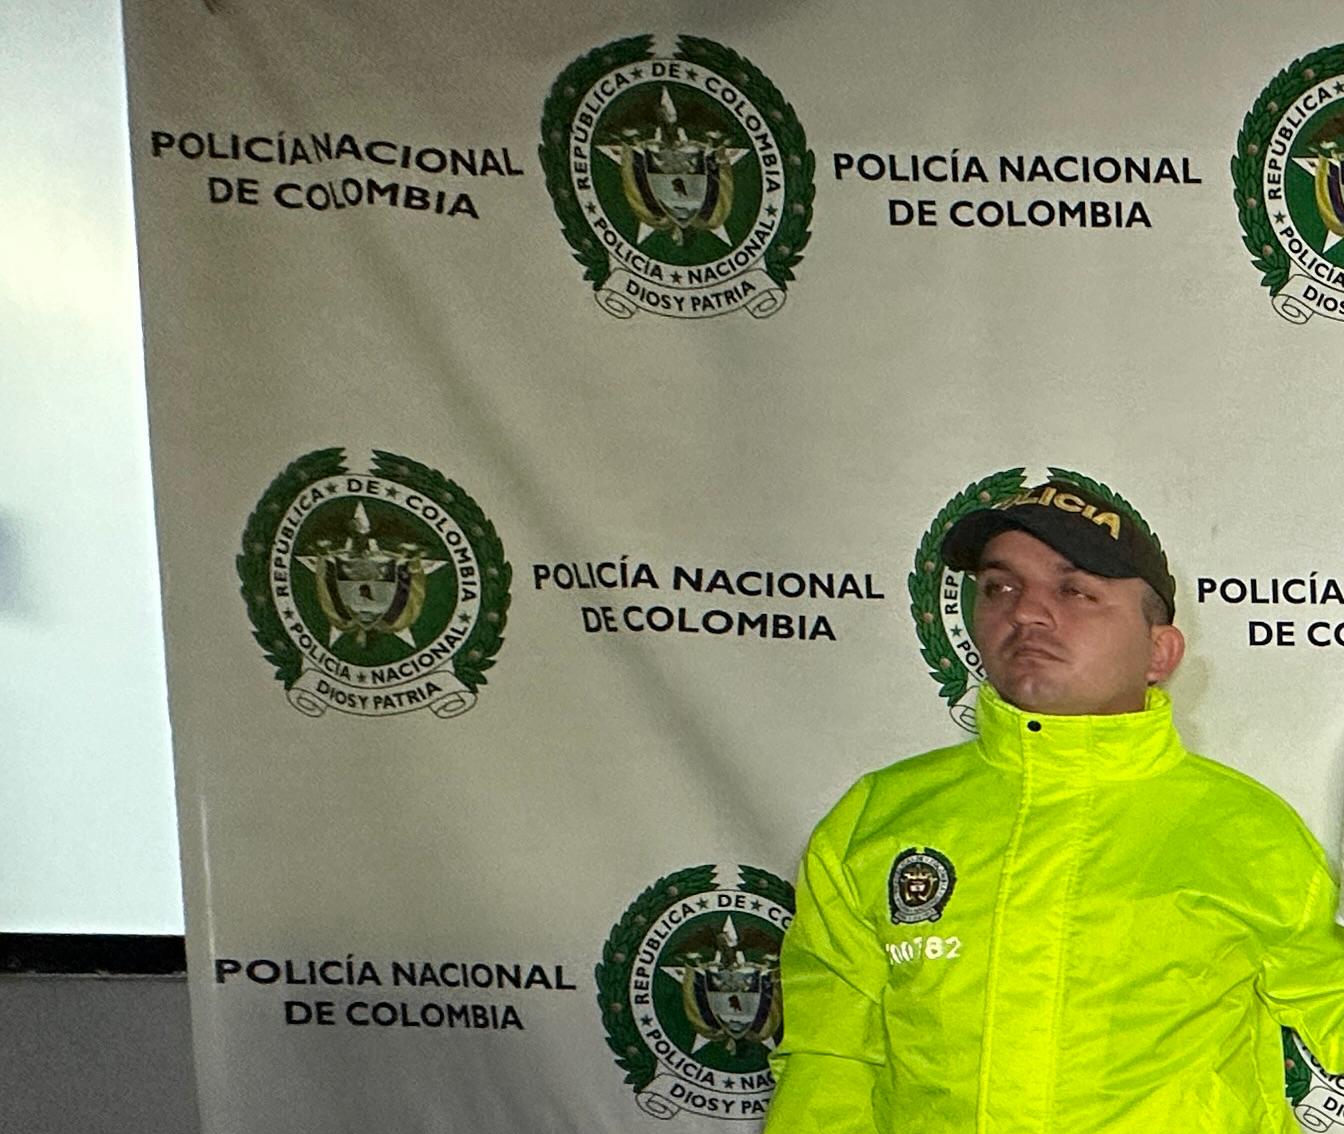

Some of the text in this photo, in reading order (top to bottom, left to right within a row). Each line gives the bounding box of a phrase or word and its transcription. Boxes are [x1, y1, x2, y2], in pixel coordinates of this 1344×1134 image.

[151, 131, 524, 176] POLICÍA NACIONAL
[834, 149, 1201, 183] POLICÍA NACIONAL
[209, 177, 479, 219] DE COLOMBIA
[889, 200, 1151, 227] DE COLOMBIA
[533, 555, 884, 599] POLICÍA NACIONAL
[1198, 572, 1344, 604] POLICÍA
[582, 606, 836, 640] DE COLOMBIA
[1249, 622, 1295, 646] DE
[718, 895, 746, 908] DE
[216, 954, 576, 990] POLICÍA NACIONAL
[285, 1001, 523, 1030] DE COLOMBIA
